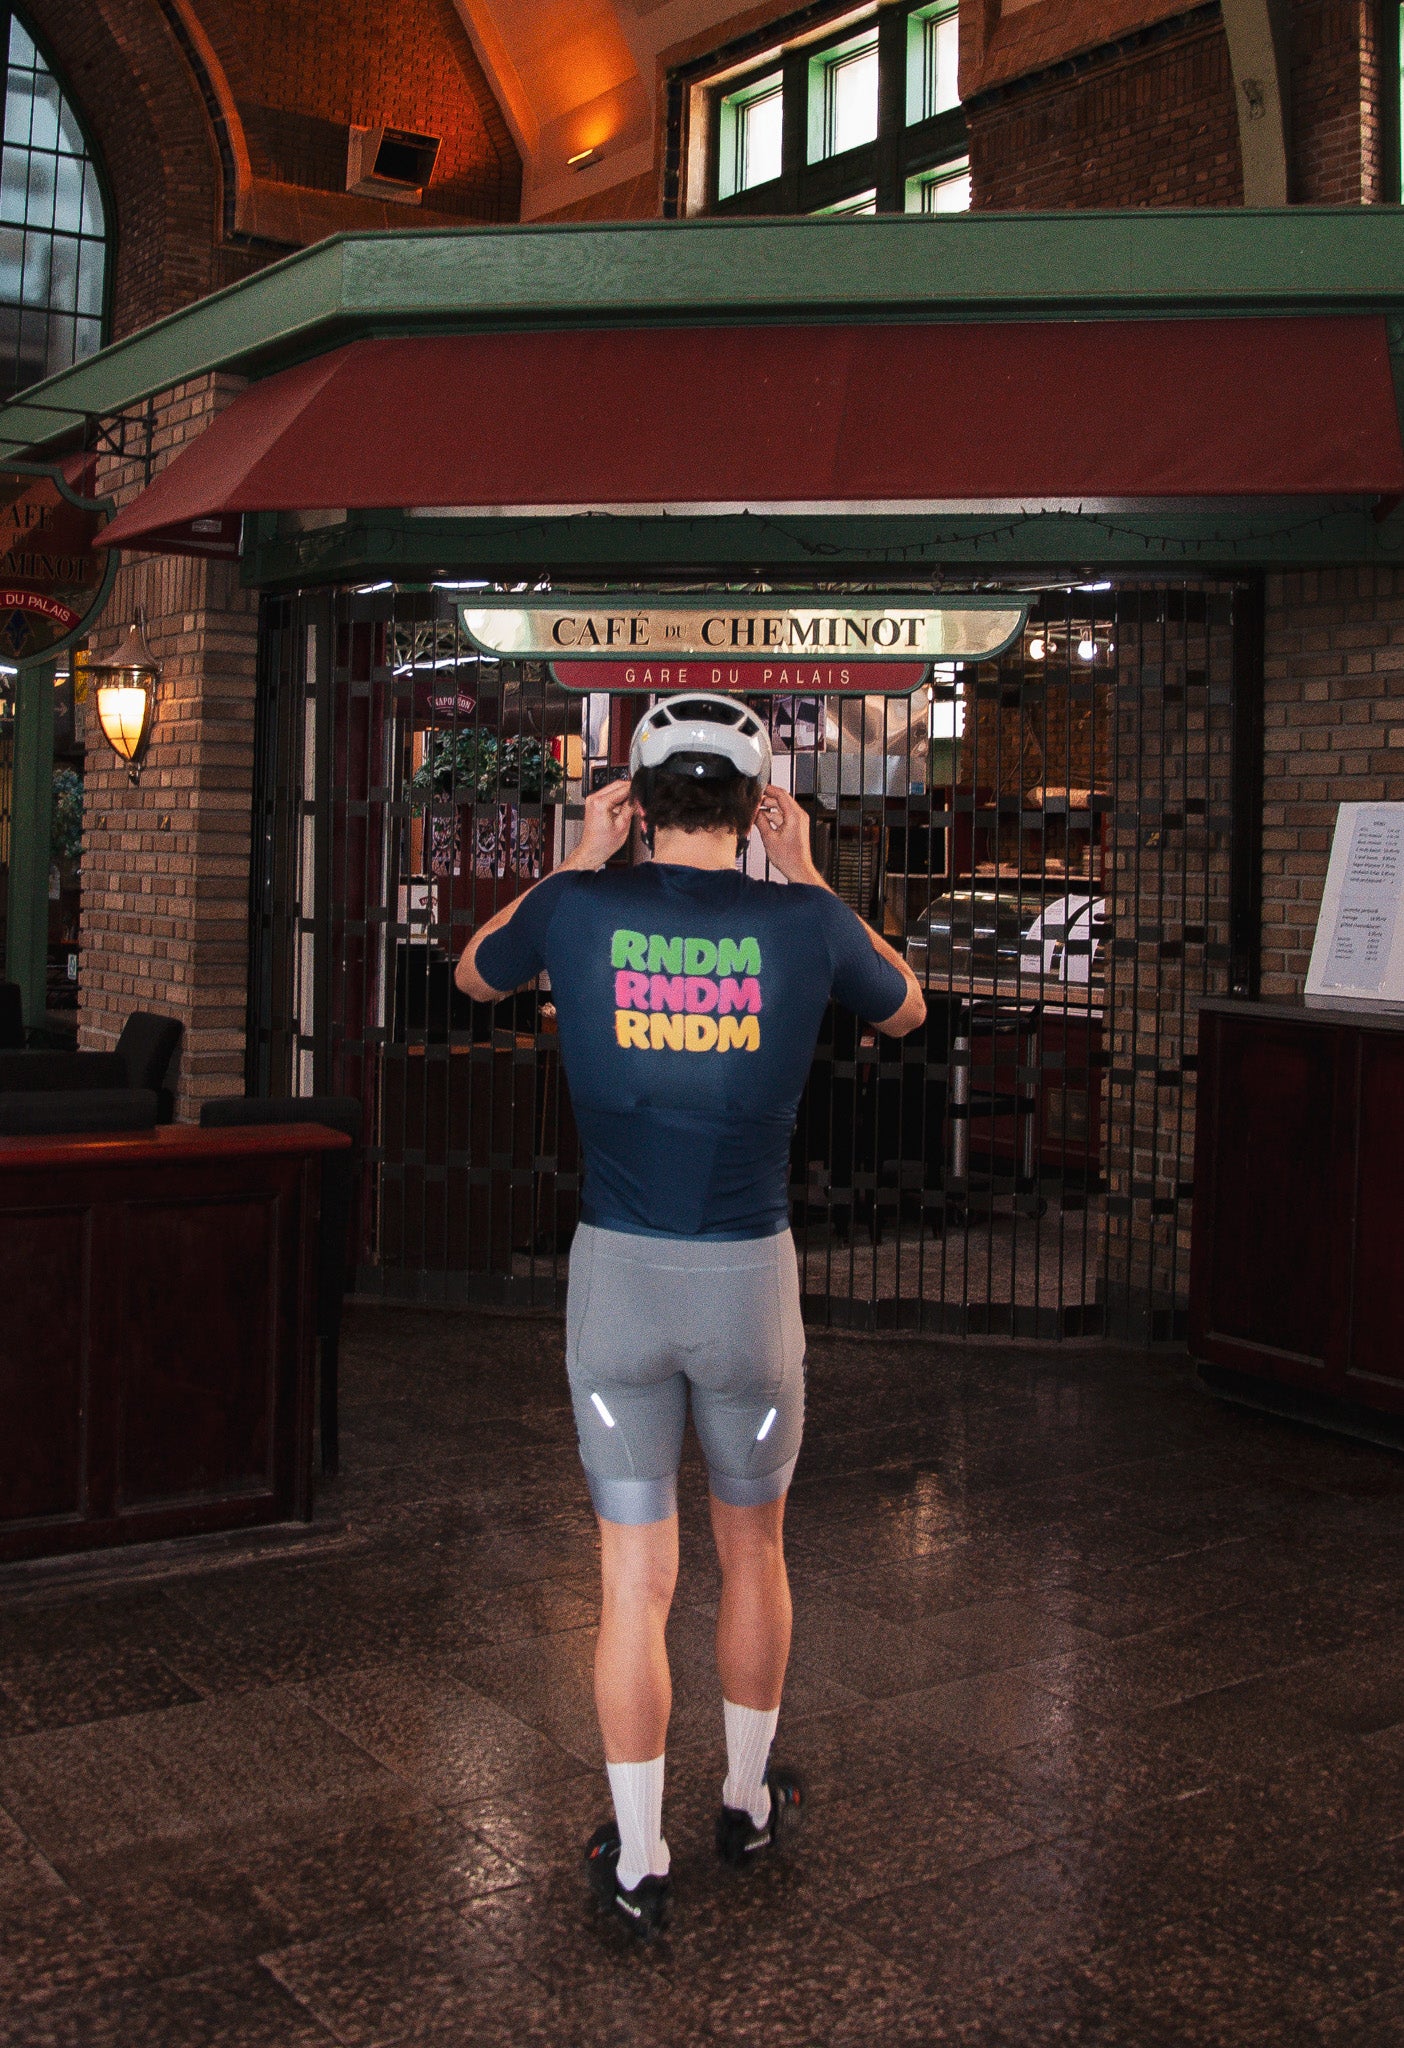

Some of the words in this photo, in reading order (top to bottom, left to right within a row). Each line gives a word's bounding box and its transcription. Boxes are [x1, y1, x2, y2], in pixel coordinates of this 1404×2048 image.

[1, 551, 88, 581] MINOT
[6, 594, 24, 605] DU
[28, 596, 71, 622] PALAIS
[552, 611, 650, 646] CAFÉ
[665, 624, 688, 638] DU
[701, 617, 925, 647] CHEMINOT
[625, 669, 687, 683] GARE
[711, 669, 739, 684] DU
[763, 669, 851, 684] PALAIS
[611, 929, 762, 977] RNDM
[615, 970, 763, 1014] RNDM
[614, 1009, 761, 1053] RNDM
